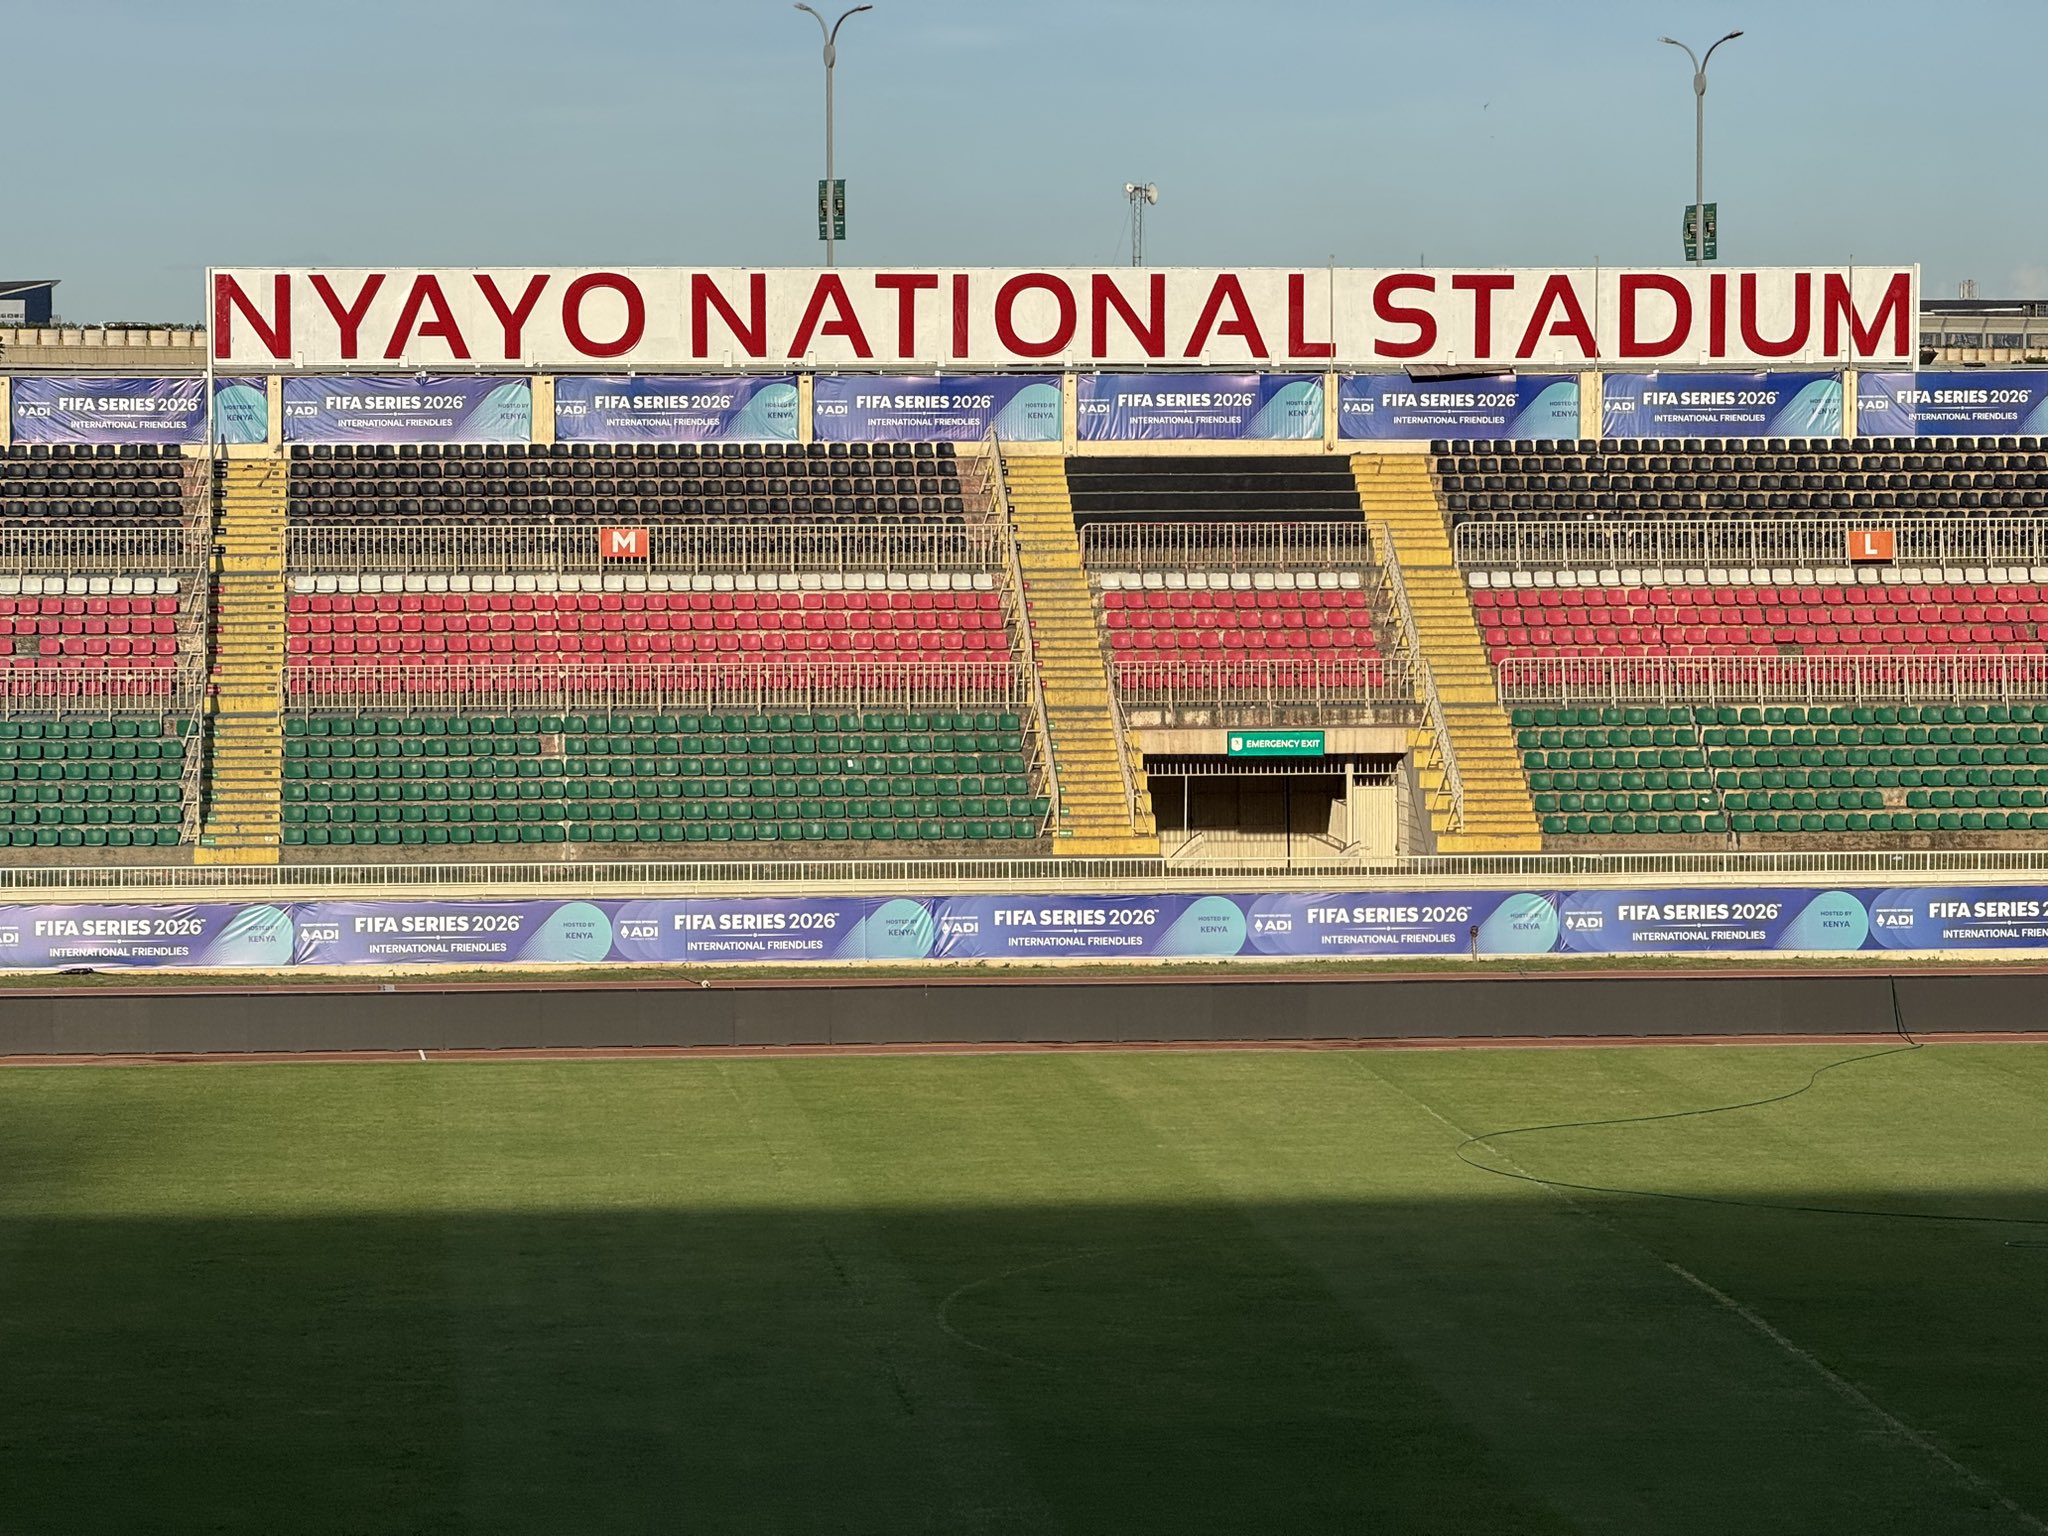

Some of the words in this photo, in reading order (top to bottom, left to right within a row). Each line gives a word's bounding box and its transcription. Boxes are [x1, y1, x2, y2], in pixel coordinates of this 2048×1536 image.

[214, 272, 646, 359] NYAYO
[692, 272, 1336, 358] NATIONAL
[1373, 272, 1910, 358] STADIUM
[1118, 394, 1153, 407] FIFA
[1156, 394, 1210, 406] SERIES
[1383, 394, 1417, 406] FIFA
[1420, 394, 1474, 406] SERIES
[1644, 392, 1678, 404] FIFA
[1681, 392, 1735, 404] SERIES
[1897, 391, 1931, 403] FIFA
[1934, 390, 1987, 403] SERIES
[59, 398, 95, 410] FIFA
[98, 396, 155, 411] SERIES
[326, 397, 362, 409] FIFA
[365, 396, 421, 409] SERIES
[595, 396, 630, 408] FIFA
[634, 396, 688, 408] SERIES
[857, 396, 891, 408] FIFA
[895, 396, 949, 408] SERIES
[1612, 402, 1634, 410] ADI
[1866, 401, 1888, 409] ADI
[26, 407, 50, 416] ADI
[295, 407, 317, 415] ADI
[563, 406, 586, 414] ADI
[825, 406, 847, 414] ADI
[1351, 404, 1373, 412] ADI
[227, 414, 254, 422] KENYA
[500, 412, 527, 420] KENYA
[767, 411, 794, 420] KENYA
[1028, 411, 1054, 420] KENYA
[1552, 410, 1578, 418] KENYA
[338, 419, 404, 427] INTERNATIONAL
[674, 418, 719, 426] FRIENDLIES
[934, 418, 980, 426] FRIENDLIES
[612, 532, 636, 553] M
[1864, 533, 1878, 554] L
[1246, 740, 1299, 748] EMERGENCY
[1301, 740, 1320, 748] EXIT
[1619, 905, 1660, 920] FIFA
[1664, 904, 1728, 920] SERIES
[1930, 903, 1971, 917] FIFA
[1975, 902, 2039, 917] SERIES
[995, 910, 1036, 925] FIFA
[1040, 910, 1105, 925] SERIES
[1308, 908, 1349, 923] FIFA
[1353, 907, 1418, 923] SERIES
[356, 917, 398, 932] FIFA
[402, 916, 469, 932] SERIES
[675, 915, 716, 929] FIFA
[720, 914, 785, 929] SERIES
[1576, 918, 1602, 927] ADI
[1823, 920, 1850, 928] KENYA
[1887, 915, 1913, 925] ADI
[36, 921, 79, 936] FIFA
[82, 920, 150, 935] SERIES
[952, 923, 978, 932] ADI
[1265, 921, 1291, 930] ADI
[1512, 923, 1540, 931] KENYA
[309, 930, 338, 941] ADI
[566, 932, 593, 940] KENYA
[631, 927, 658, 936] ADI
[888, 928, 916, 936] KENYA
[1633, 932, 1709, 941] INTERNATIONAL
[1712, 931, 1765, 939] FRIENDLIES
[1943, 929, 2019, 938] INTERNATIONAL
[248, 935, 276, 943] KENYA
[1009, 937, 1085, 946] INTERNATIONAL
[1088, 937, 1142, 945] FRIENDLIES
[1322, 935, 1398, 944] INTERNATIONAL
[1401, 934, 1455, 942] FRIENDLIES
[370, 944, 448, 953] INTERNATIONAL
[451, 943, 506, 951] FRIENDLIES
[688, 942, 765, 950] INTERNATIONAL
[768, 941, 823, 949] FRIENDLIES
[50, 947, 130, 956] INTERNATIONAL
[132, 947, 188, 955] FRIENDLIES
